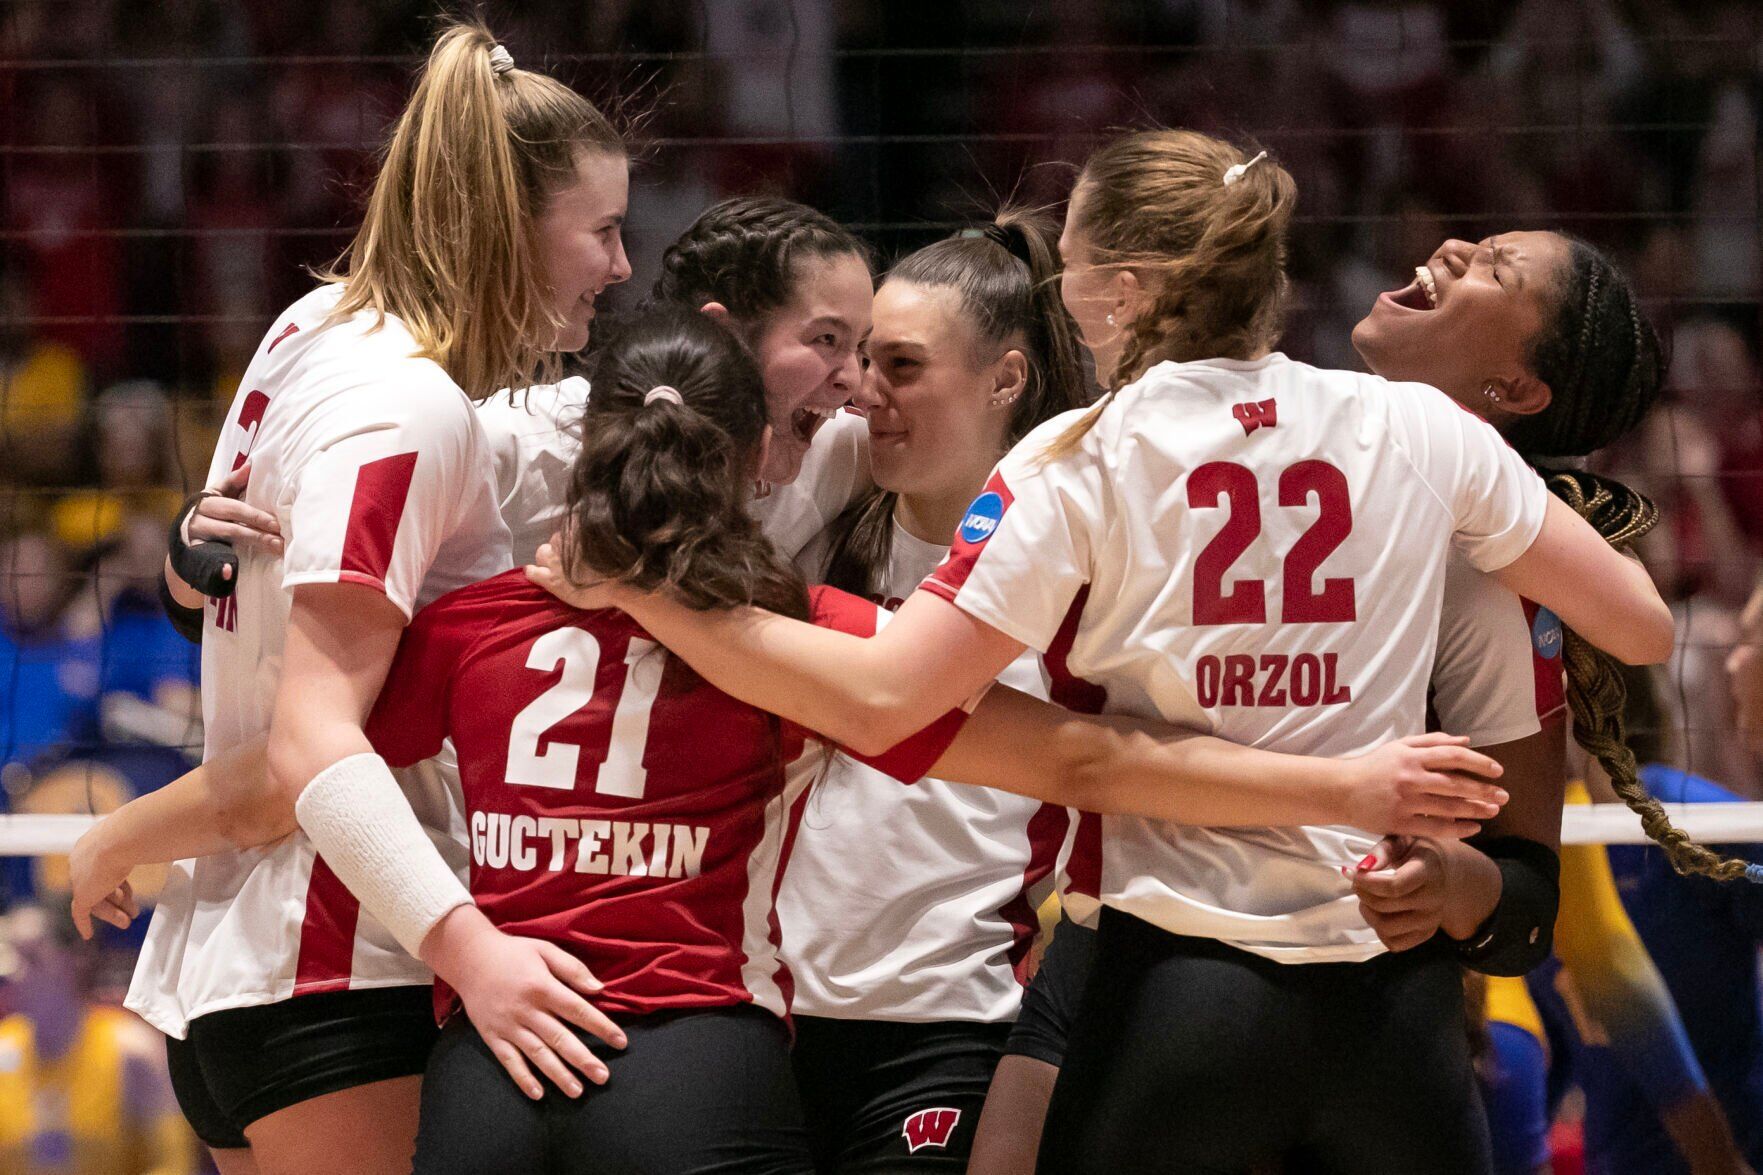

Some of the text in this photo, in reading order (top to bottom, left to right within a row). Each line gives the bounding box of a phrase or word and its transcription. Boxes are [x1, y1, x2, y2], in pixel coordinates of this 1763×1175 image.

[1232, 397, 1277, 437] W
[1186, 459, 1356, 625] 22
[1196, 653, 1352, 708] ORZOL
[504, 627, 668, 799] 21
[471, 811, 710, 878] GUCTEKIN
[901, 1107, 962, 1155] W
